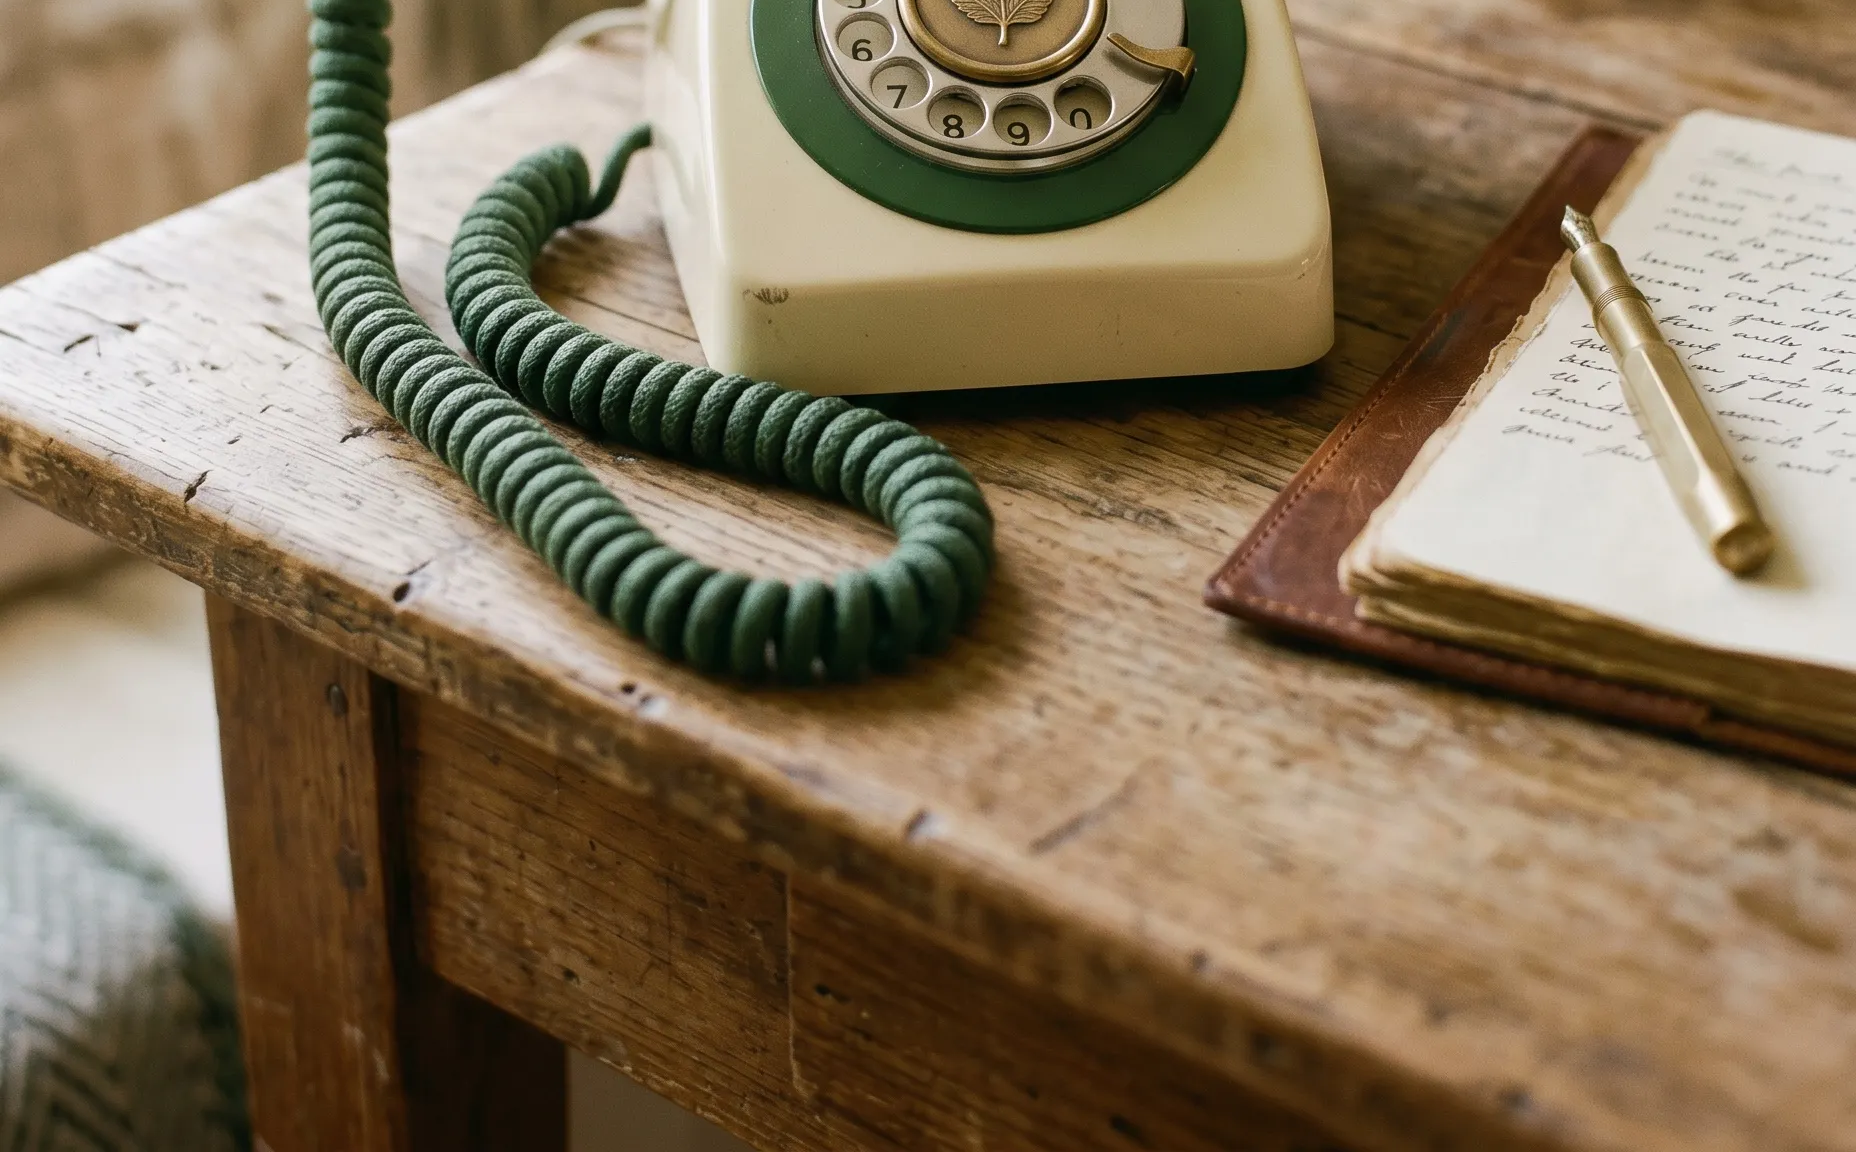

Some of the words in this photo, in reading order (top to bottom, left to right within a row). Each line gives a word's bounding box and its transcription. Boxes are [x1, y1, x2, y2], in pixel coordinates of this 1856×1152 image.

[851, 38, 873, 62] 6
[886, 84, 908, 109] 7
[942, 114, 965, 138] 8
[1069, 108, 1092, 130] 0
[1007, 121, 1030, 146] 9
